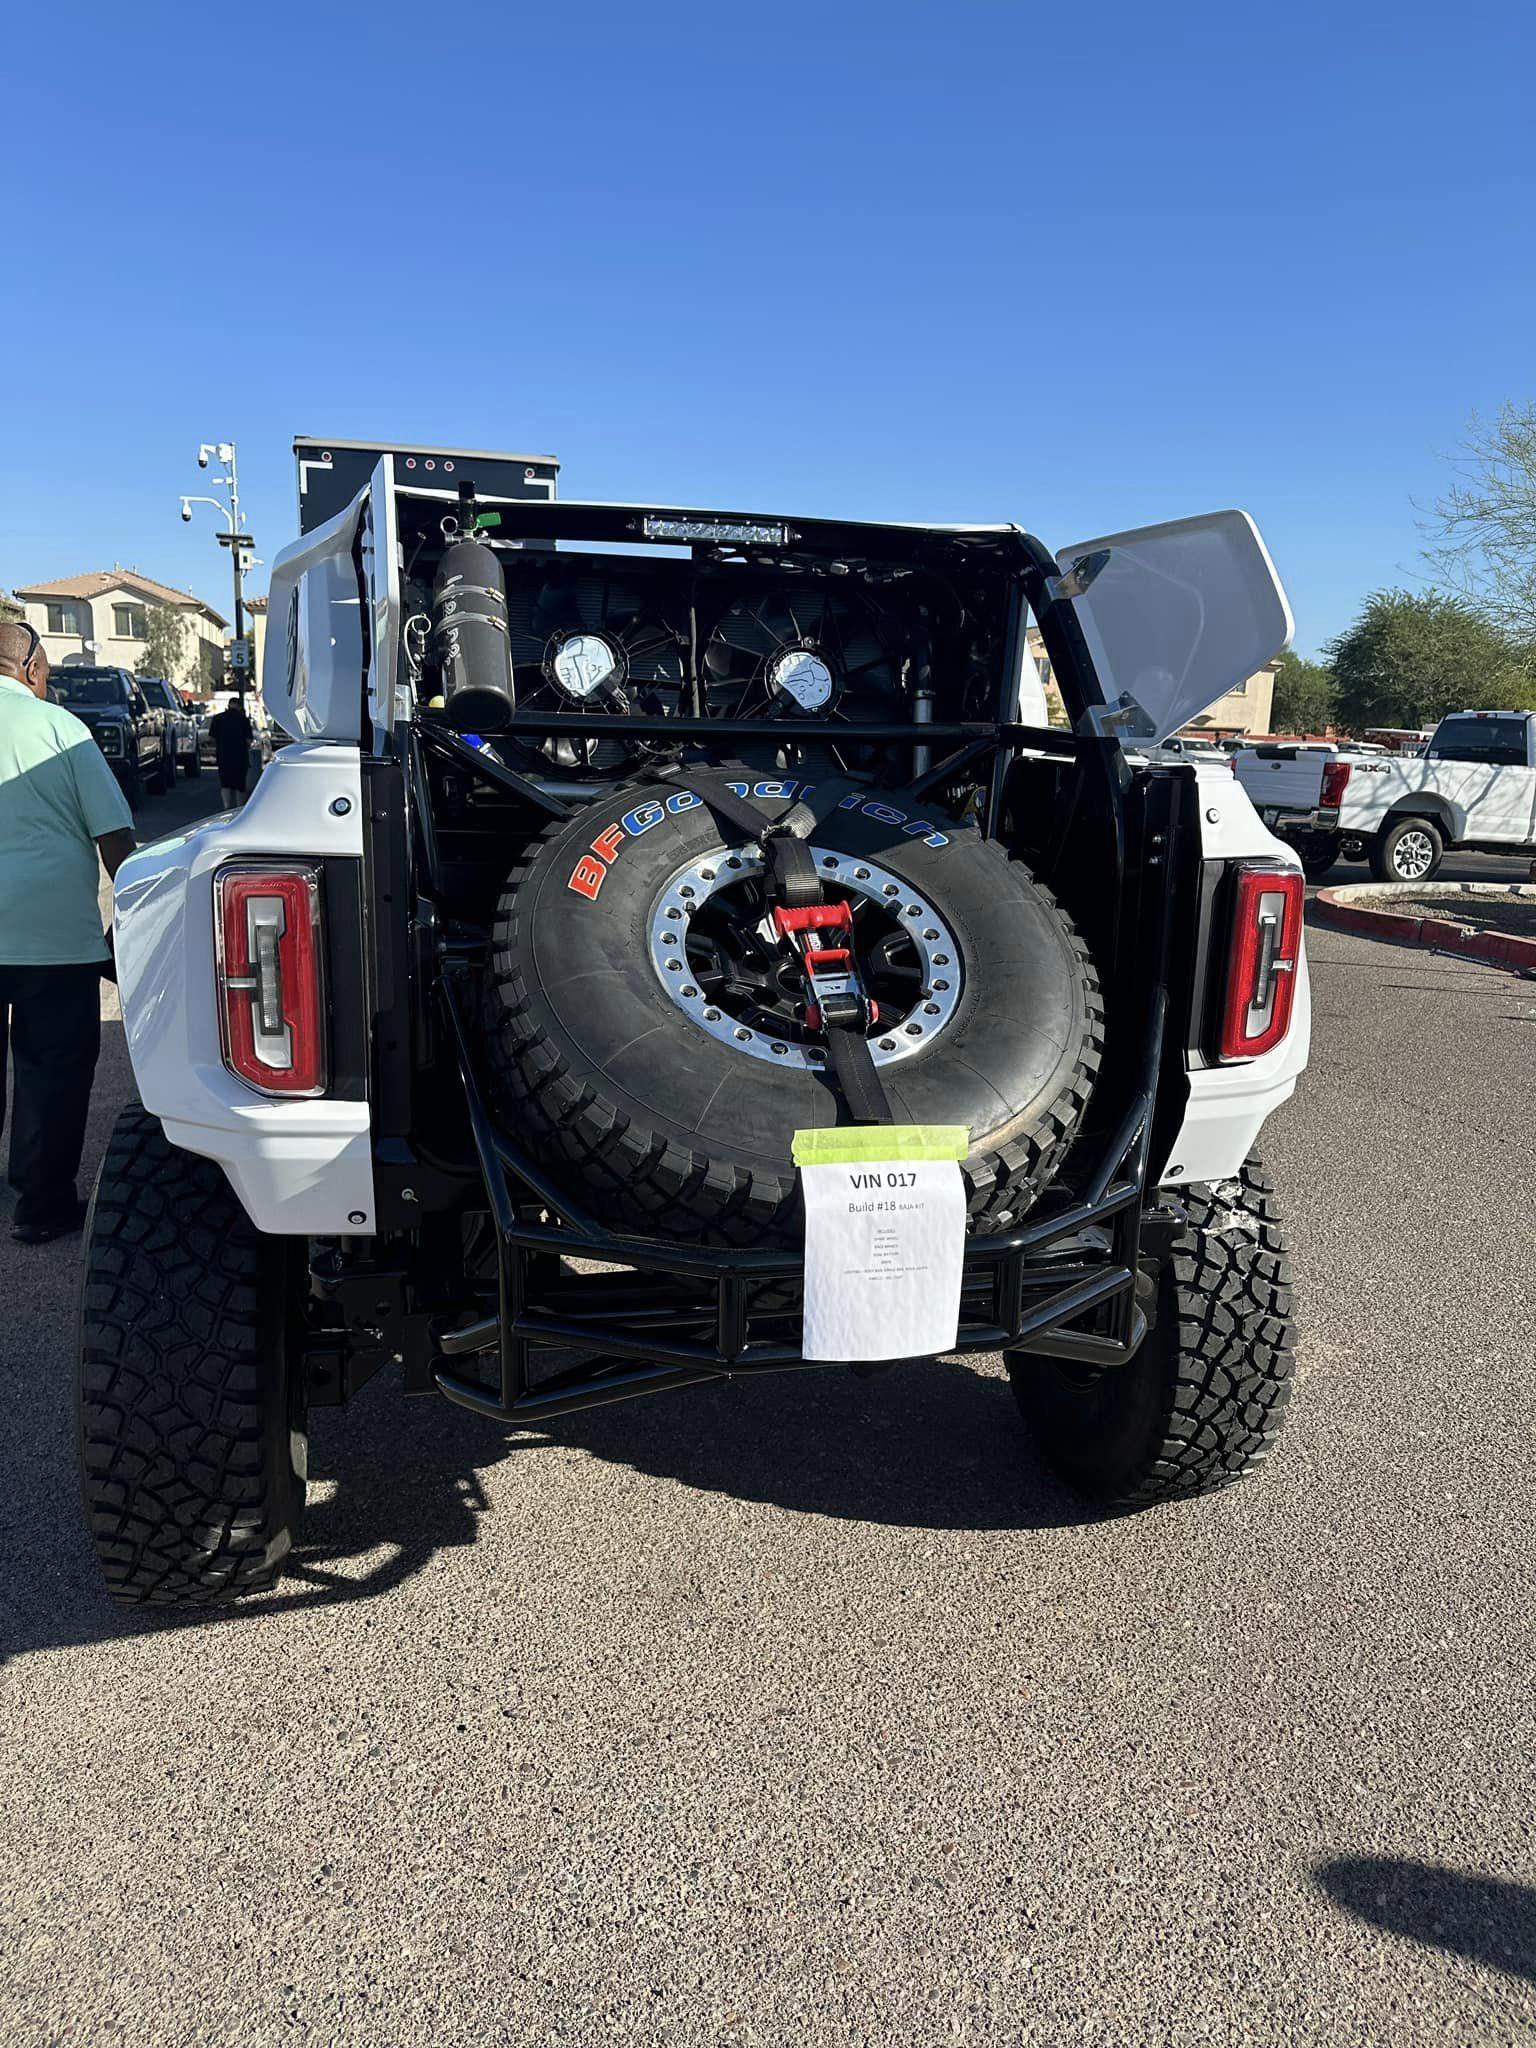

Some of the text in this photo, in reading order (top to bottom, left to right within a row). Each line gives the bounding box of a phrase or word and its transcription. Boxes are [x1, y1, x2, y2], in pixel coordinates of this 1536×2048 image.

[236, 652, 244, 664] 5
[849, 1172, 917, 1189] VIN 017
[848, 1201, 874, 1213] Build
[877, 1200, 896, 1211] #18
